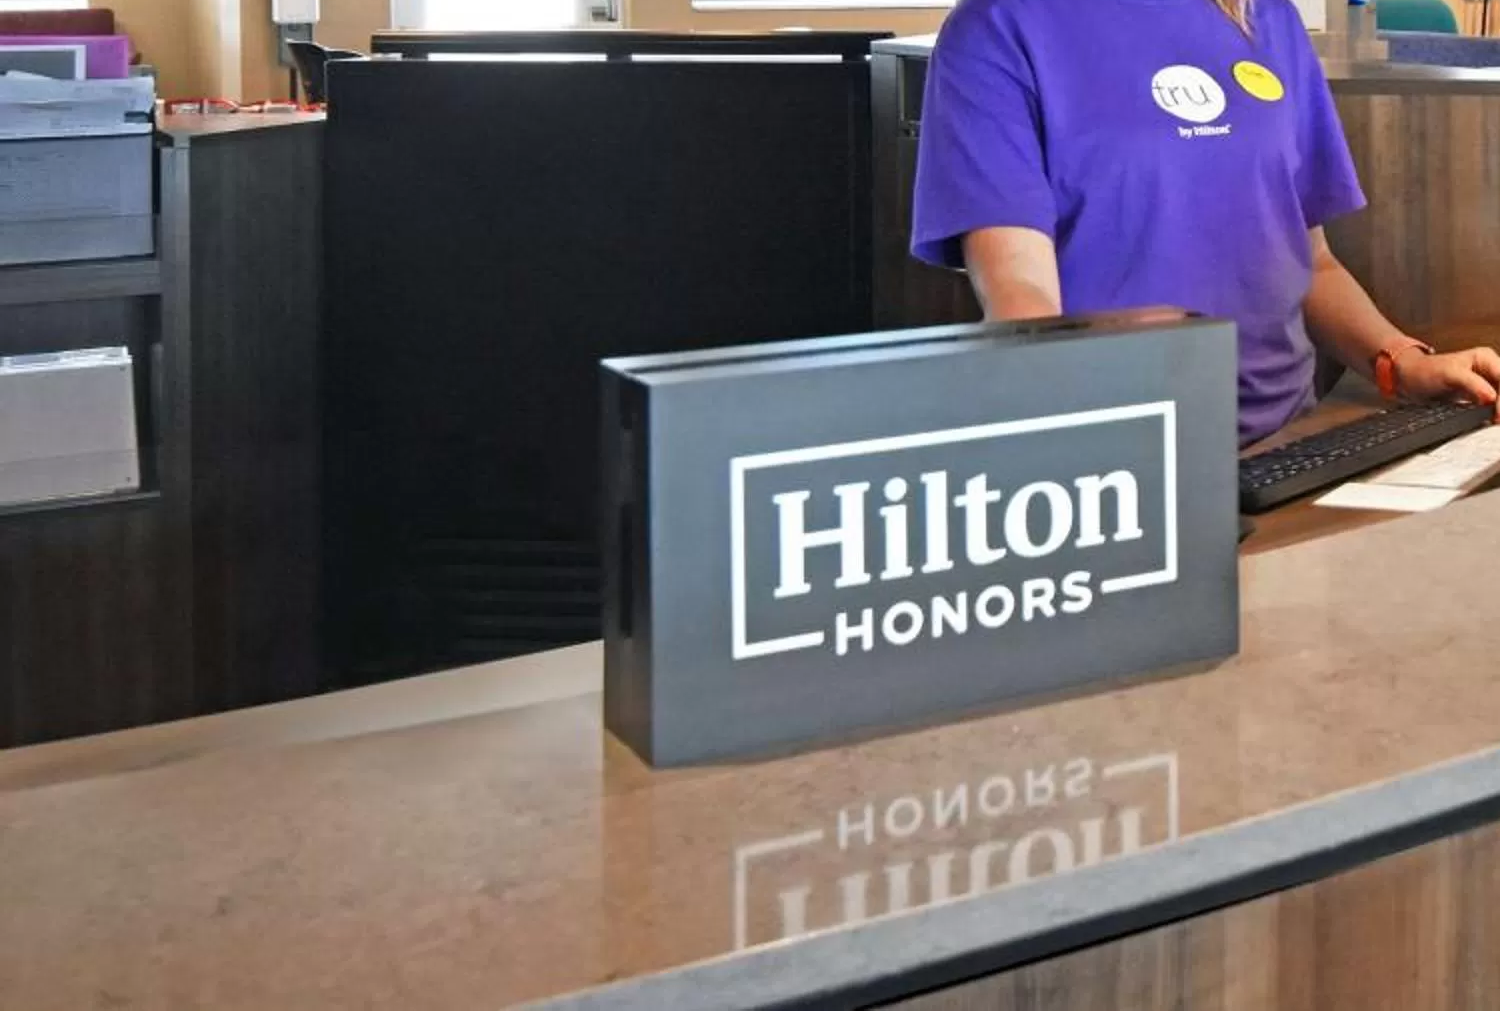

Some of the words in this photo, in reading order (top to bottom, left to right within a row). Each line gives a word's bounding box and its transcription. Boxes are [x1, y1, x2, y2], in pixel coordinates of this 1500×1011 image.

[1152, 80, 1211, 109] tru
[1177, 126, 1193, 140] by
[773, 469, 1143, 599] Hilton
[834, 571, 1094, 656] HONORS
